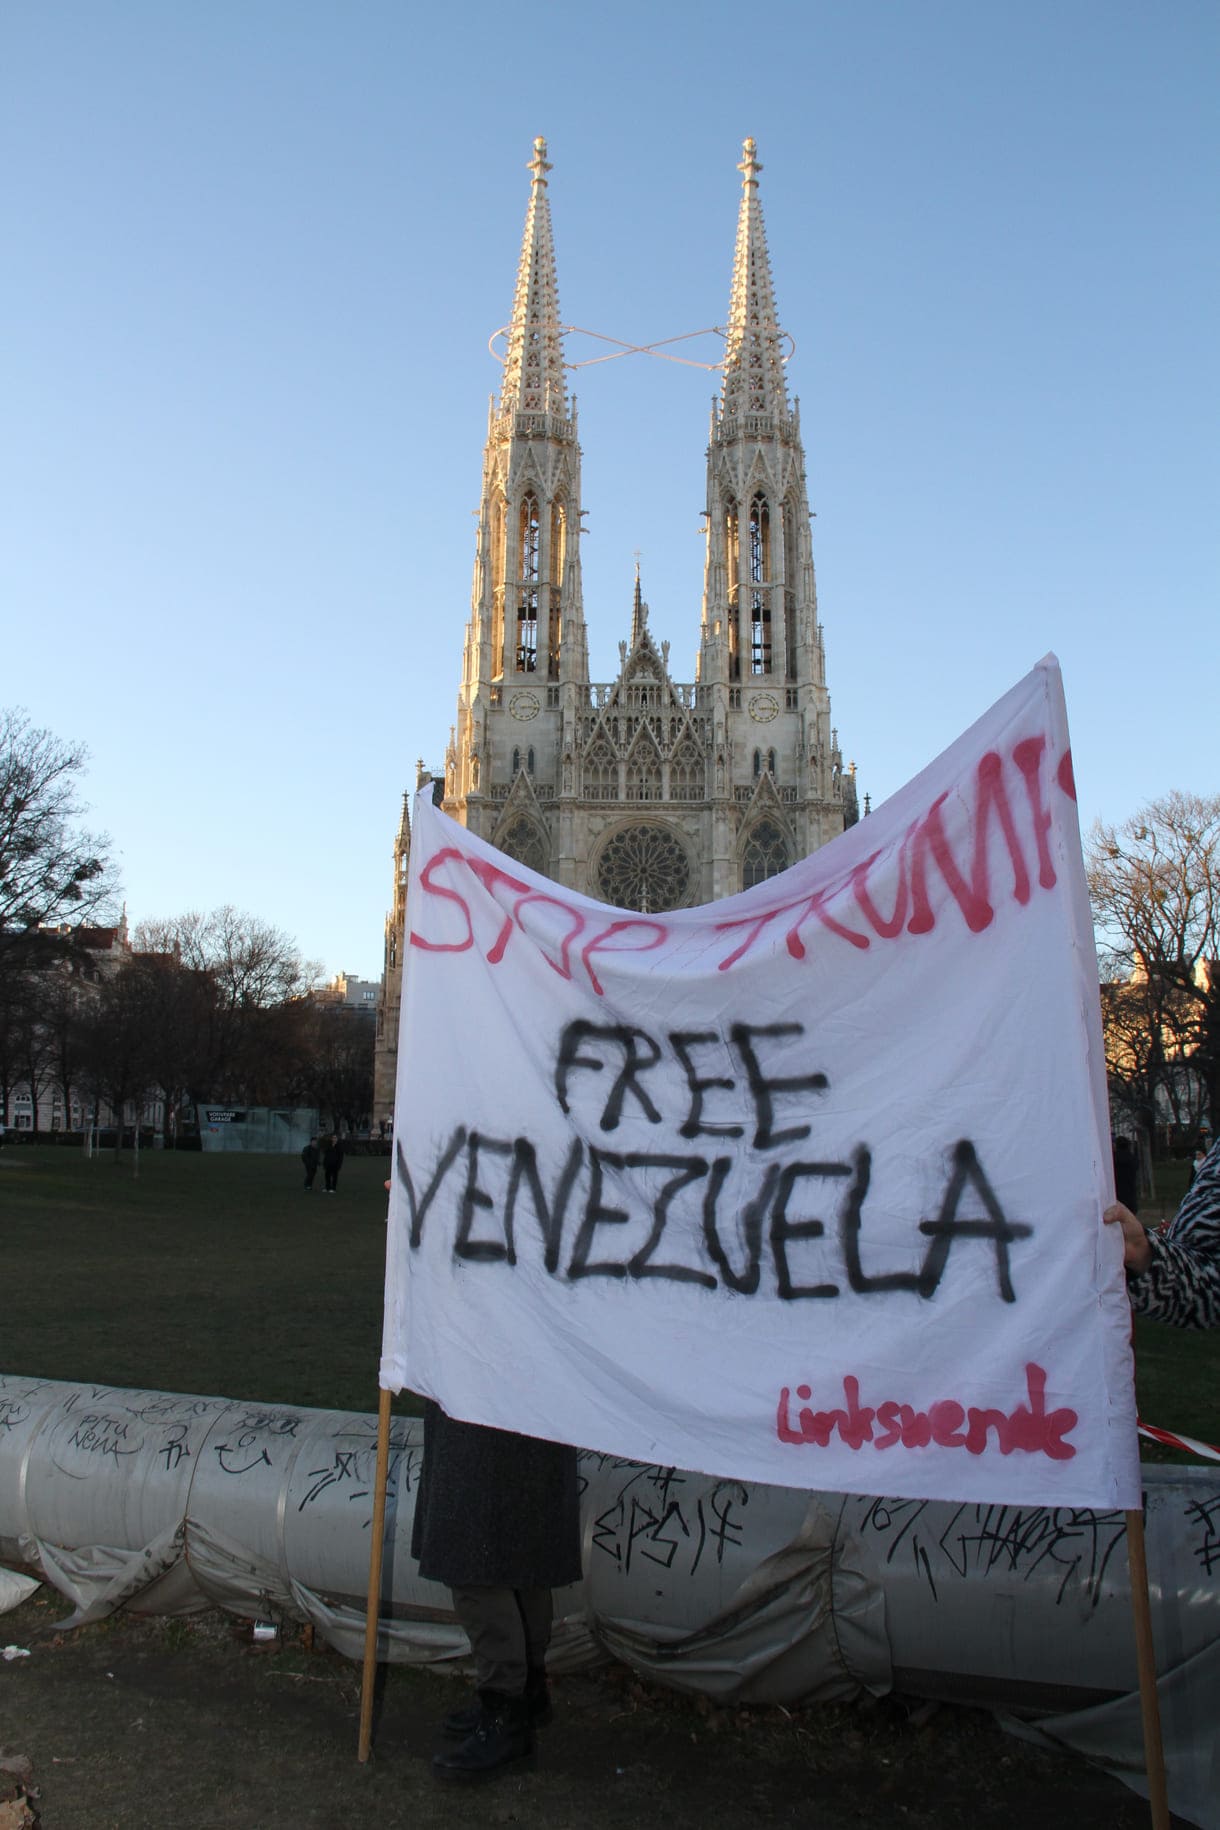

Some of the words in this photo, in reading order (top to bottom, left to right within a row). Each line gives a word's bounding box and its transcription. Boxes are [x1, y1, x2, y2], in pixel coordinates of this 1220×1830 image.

[410, 847, 669, 996] STOP
[554, 1018, 830, 1151] FREE
[396, 1125, 1034, 1304] VENEZUELA
[777, 1361, 1079, 1460] Linkswende
